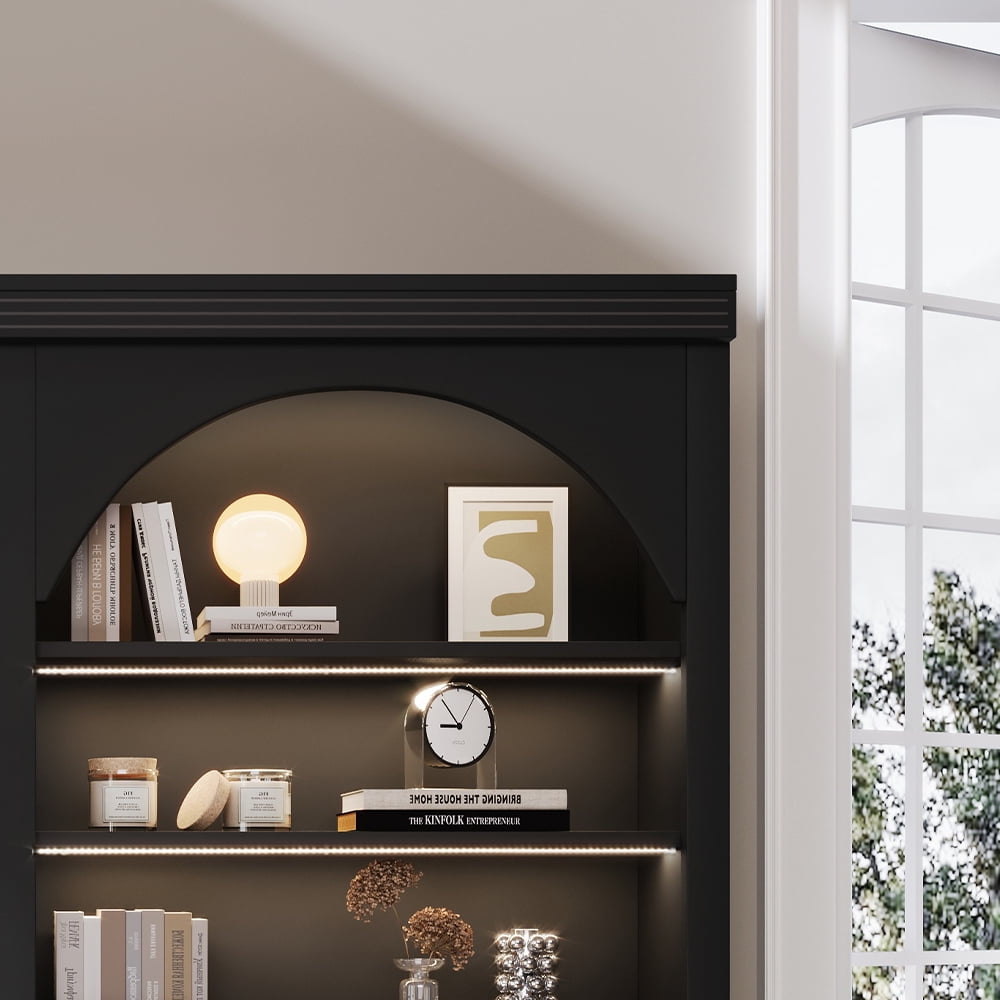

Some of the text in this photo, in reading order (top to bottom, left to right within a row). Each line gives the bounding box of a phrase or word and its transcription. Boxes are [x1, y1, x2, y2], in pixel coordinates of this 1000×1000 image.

[408, 815, 521, 825] THE KINFOLK ENTREPRENEUR
